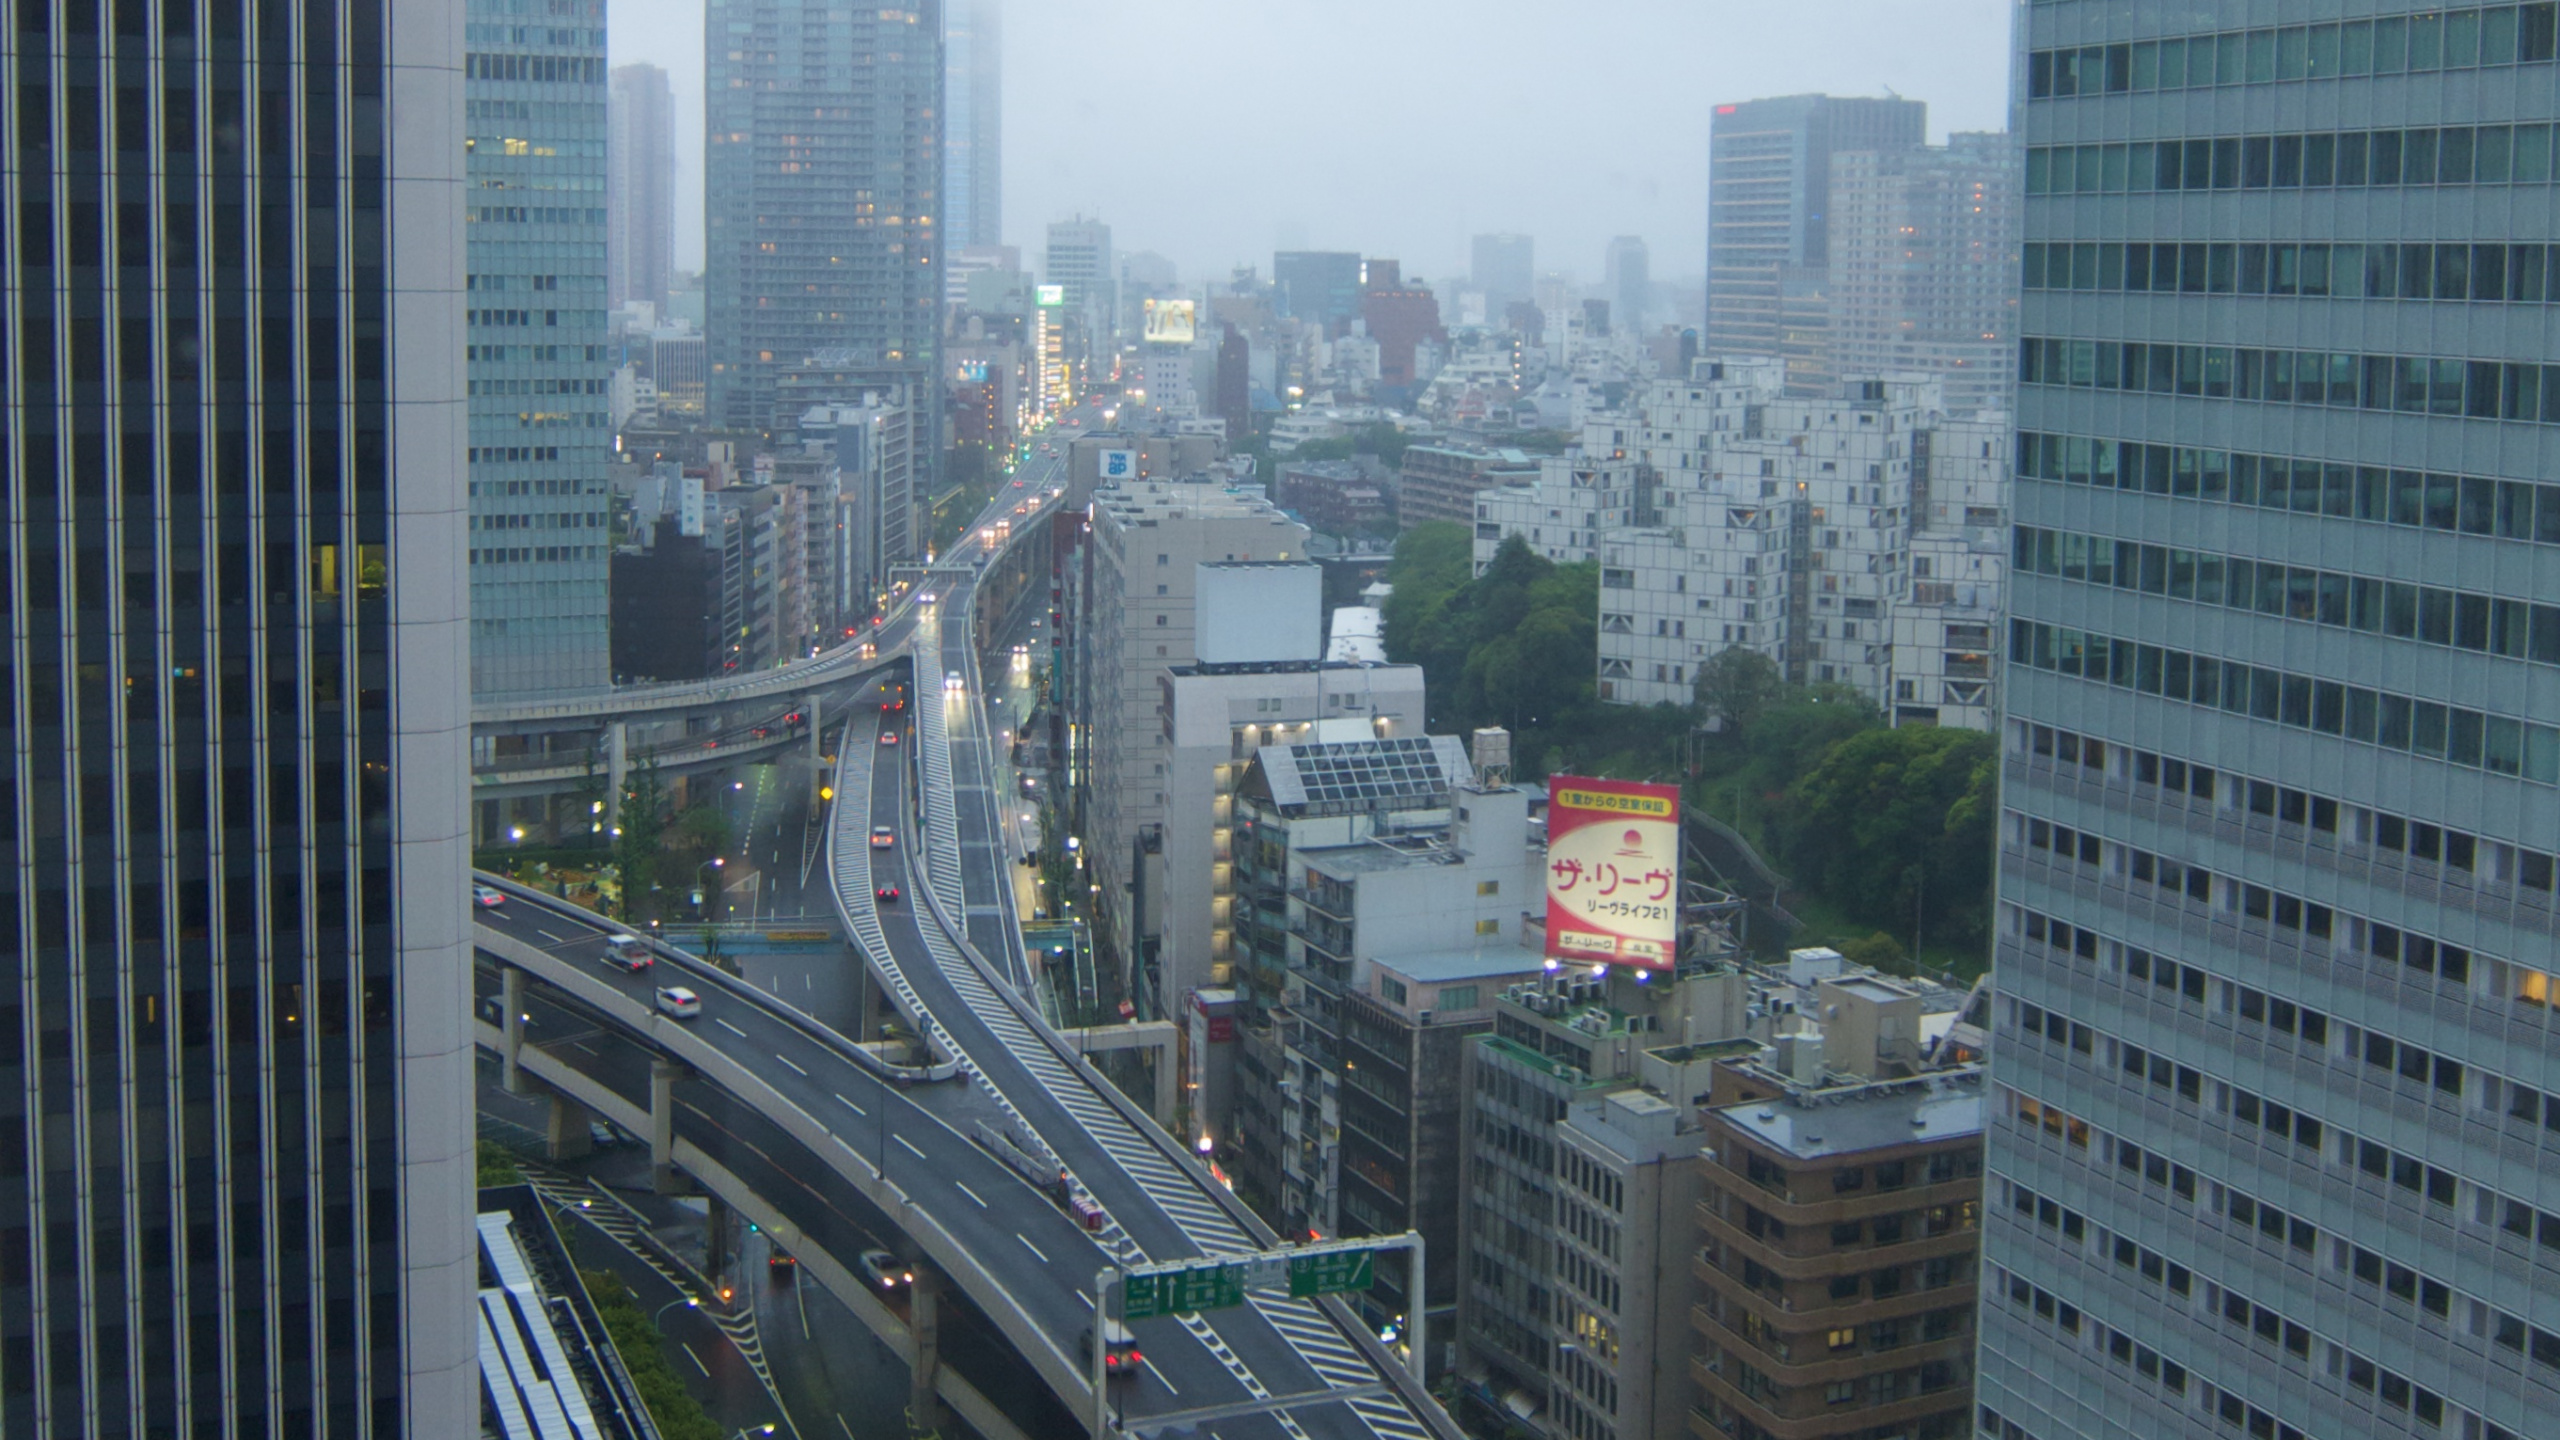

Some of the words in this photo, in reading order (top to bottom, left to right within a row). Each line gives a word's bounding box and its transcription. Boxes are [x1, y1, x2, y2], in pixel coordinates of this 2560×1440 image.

[1563, 792, 1664, 813] 1室からの空室保証
[1550, 857, 1674, 901] ザ・リーヴ
[1588, 899, 1668, 920] リーヴライフ21
